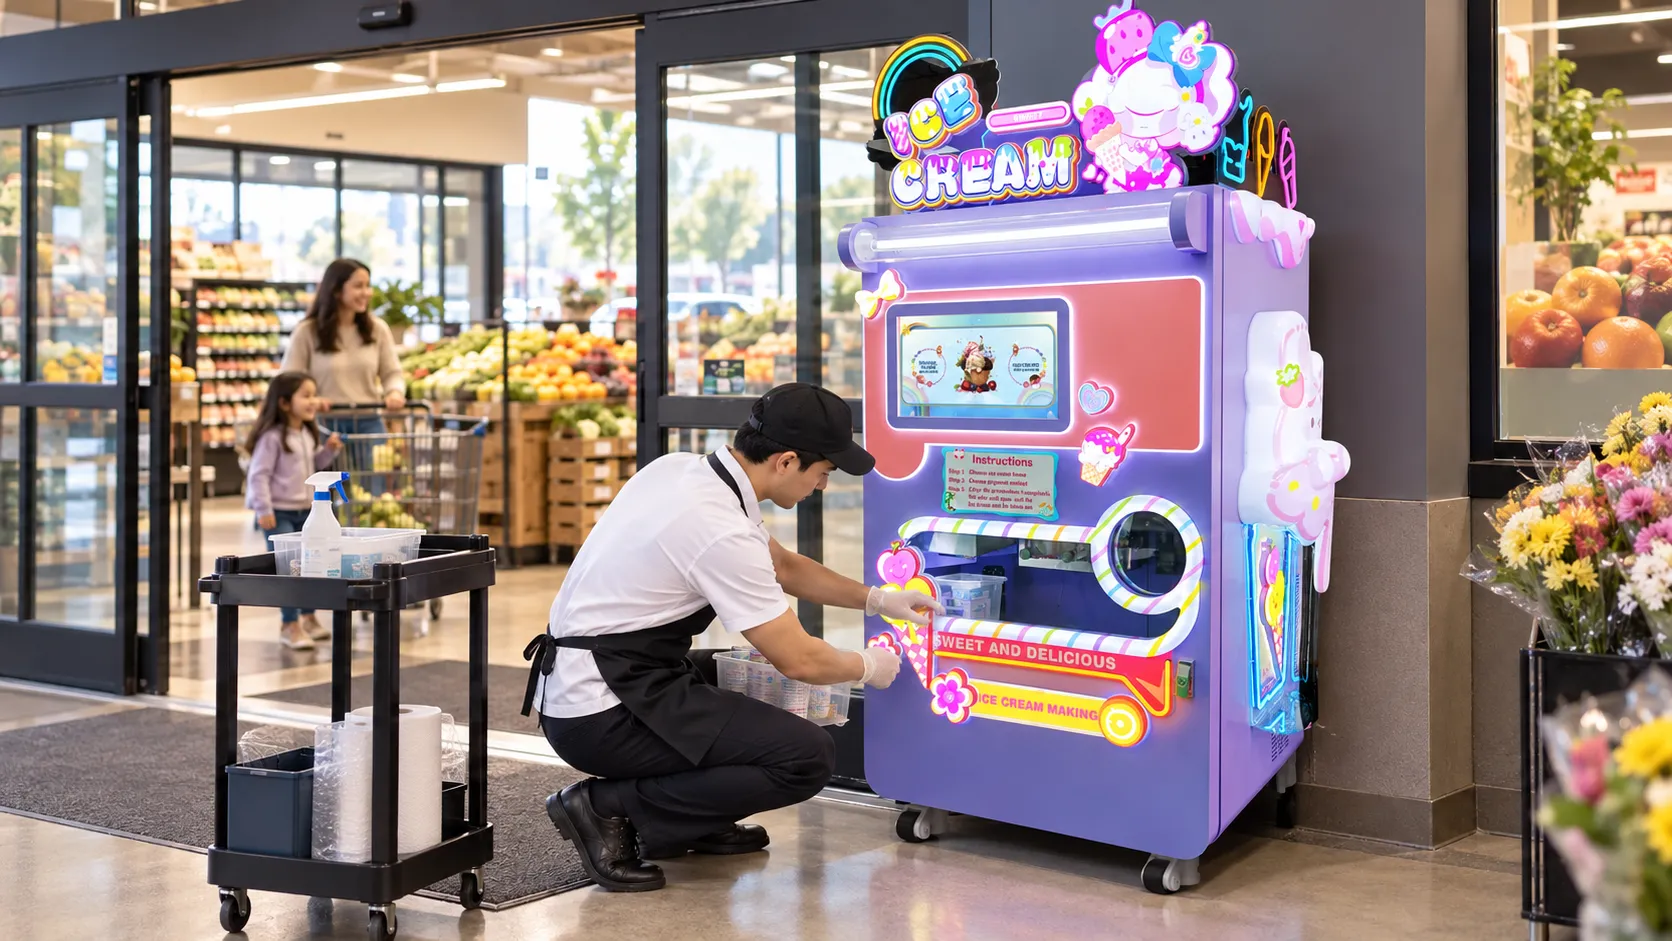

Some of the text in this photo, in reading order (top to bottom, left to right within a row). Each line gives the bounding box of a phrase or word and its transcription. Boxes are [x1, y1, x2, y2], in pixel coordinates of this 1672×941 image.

[884, 73, 981, 159] ICE
[891, 134, 1079, 209] CREAM
[972, 454, 1033, 467] Instructions
[934, 634, 1117, 670] SWEET AND DELICIOUS
[1000, 696, 1044, 712] CREAM
[1047, 703, 1099, 721] MAKING
